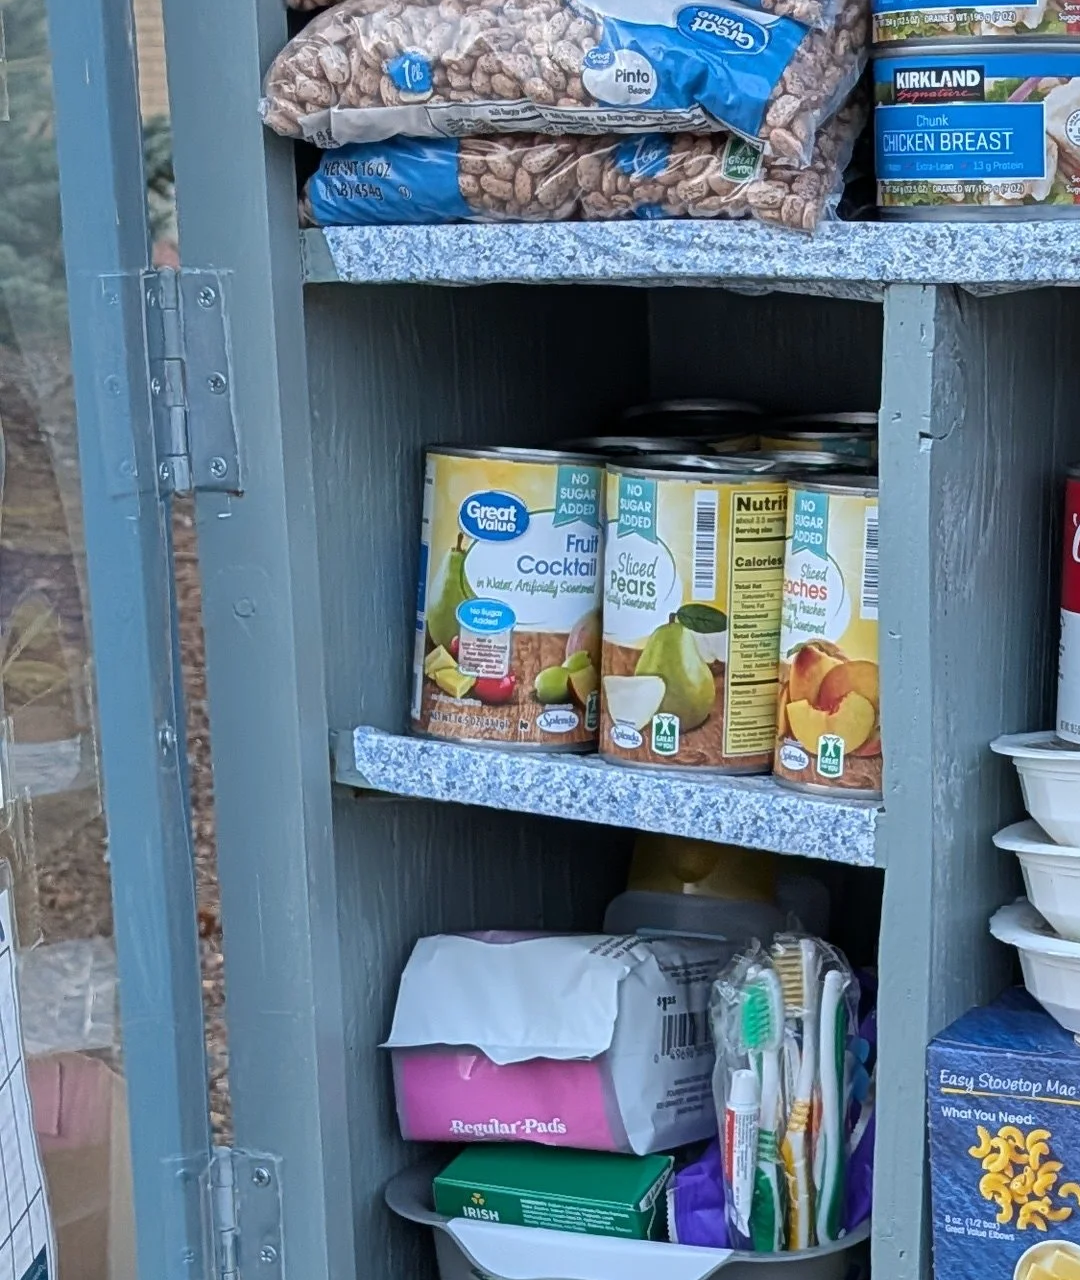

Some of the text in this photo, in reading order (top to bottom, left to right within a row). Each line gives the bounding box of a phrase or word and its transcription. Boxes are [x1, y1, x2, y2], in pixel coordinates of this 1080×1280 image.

[697, 10, 744, 32] Value
[691, 16, 755, 50] Great
[615, 68, 650, 83] Pinto
[896, 69, 981, 90] KIRKLAND
[916, 114, 949, 127] Chunk
[883, 131, 1014, 153] CHICKEN BREAST
[361, 161, 392, 178] 16 OZ
[355, 182, 384, 202] 454g
[571, 472, 589, 485] NO
[560, 486, 597, 501] SUGAR
[626, 483, 643, 496] NO
[466, 500, 518, 522] Great
[559, 502, 597, 515] ADDED
[619, 499, 652, 513] SUGAR
[800, 499, 816, 512] NO
[477, 518, 518, 533] Value
[619, 513, 652, 529] ADDED
[794, 514, 824, 529] SUGAR
[566, 533, 599, 553] Fruit
[793, 530, 823, 545] ADDED
[516, 555, 598, 578] Cocktail
[618, 551, 658, 578] Sliced
[735, 556, 783, 568] Calories
[800, 563, 828, 583] Sliced
[477, 577, 484, 589] in
[486, 576, 512, 591] Water,
[514, 576, 558, 597] Artificially
[610, 569, 656, 598] Pears
[540, 712, 577, 728] Splenda
[656, 734, 675, 743] GREAT
[940, 1070, 974, 1093] Easy
[978, 1073, 1042, 1097] Stovetop
[1046, 1079, 1077, 1097] Mac
[941, 1106, 1036, 1126] What You Need:
[450, 1117, 567, 1137] Regular Pads
[462, 1205, 500, 1222] IRISH
[945, 1224, 1016, 1241] Great Value Elbows
